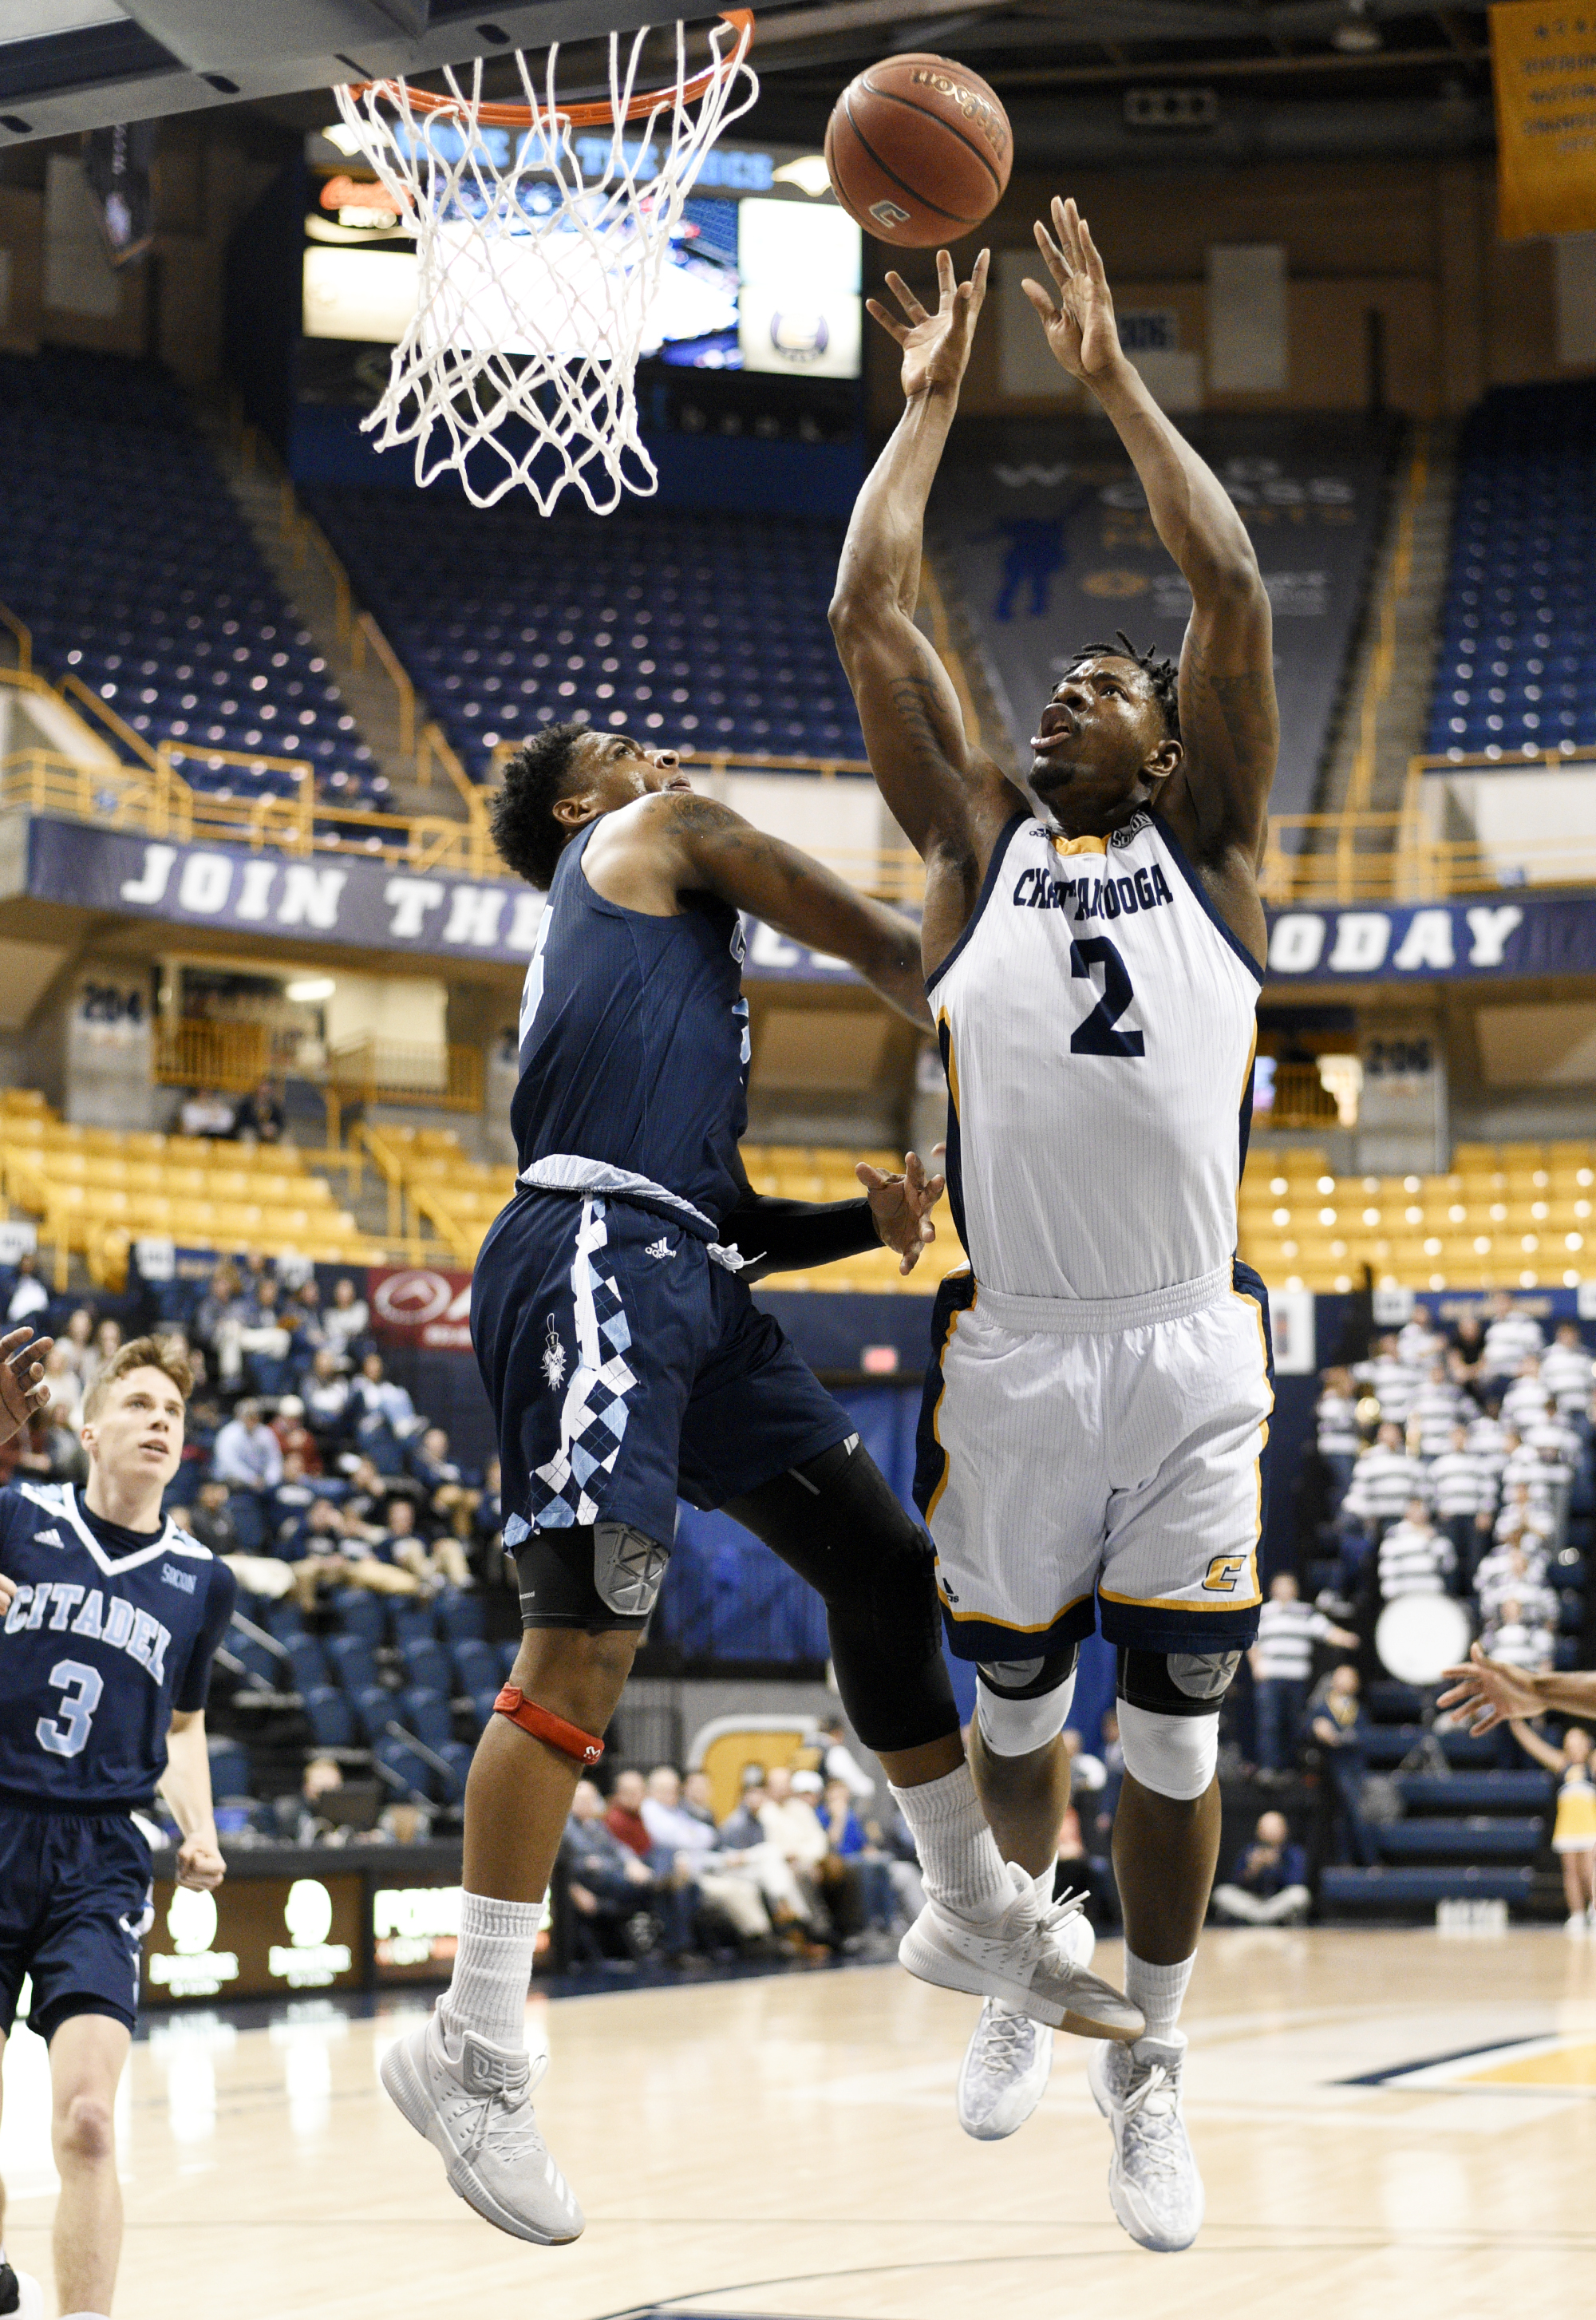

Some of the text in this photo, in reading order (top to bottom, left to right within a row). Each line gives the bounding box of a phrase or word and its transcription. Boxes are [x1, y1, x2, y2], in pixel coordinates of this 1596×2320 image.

[120, 844, 349, 929] JOIN
[1268, 906, 1523, 973] ODAY
[1070, 935, 1145, 1057] 2
[1202, 1554, 1246, 1592] C
[4, 1583, 172, 1686] CITADEL
[35, 1658, 104, 1757] 3
